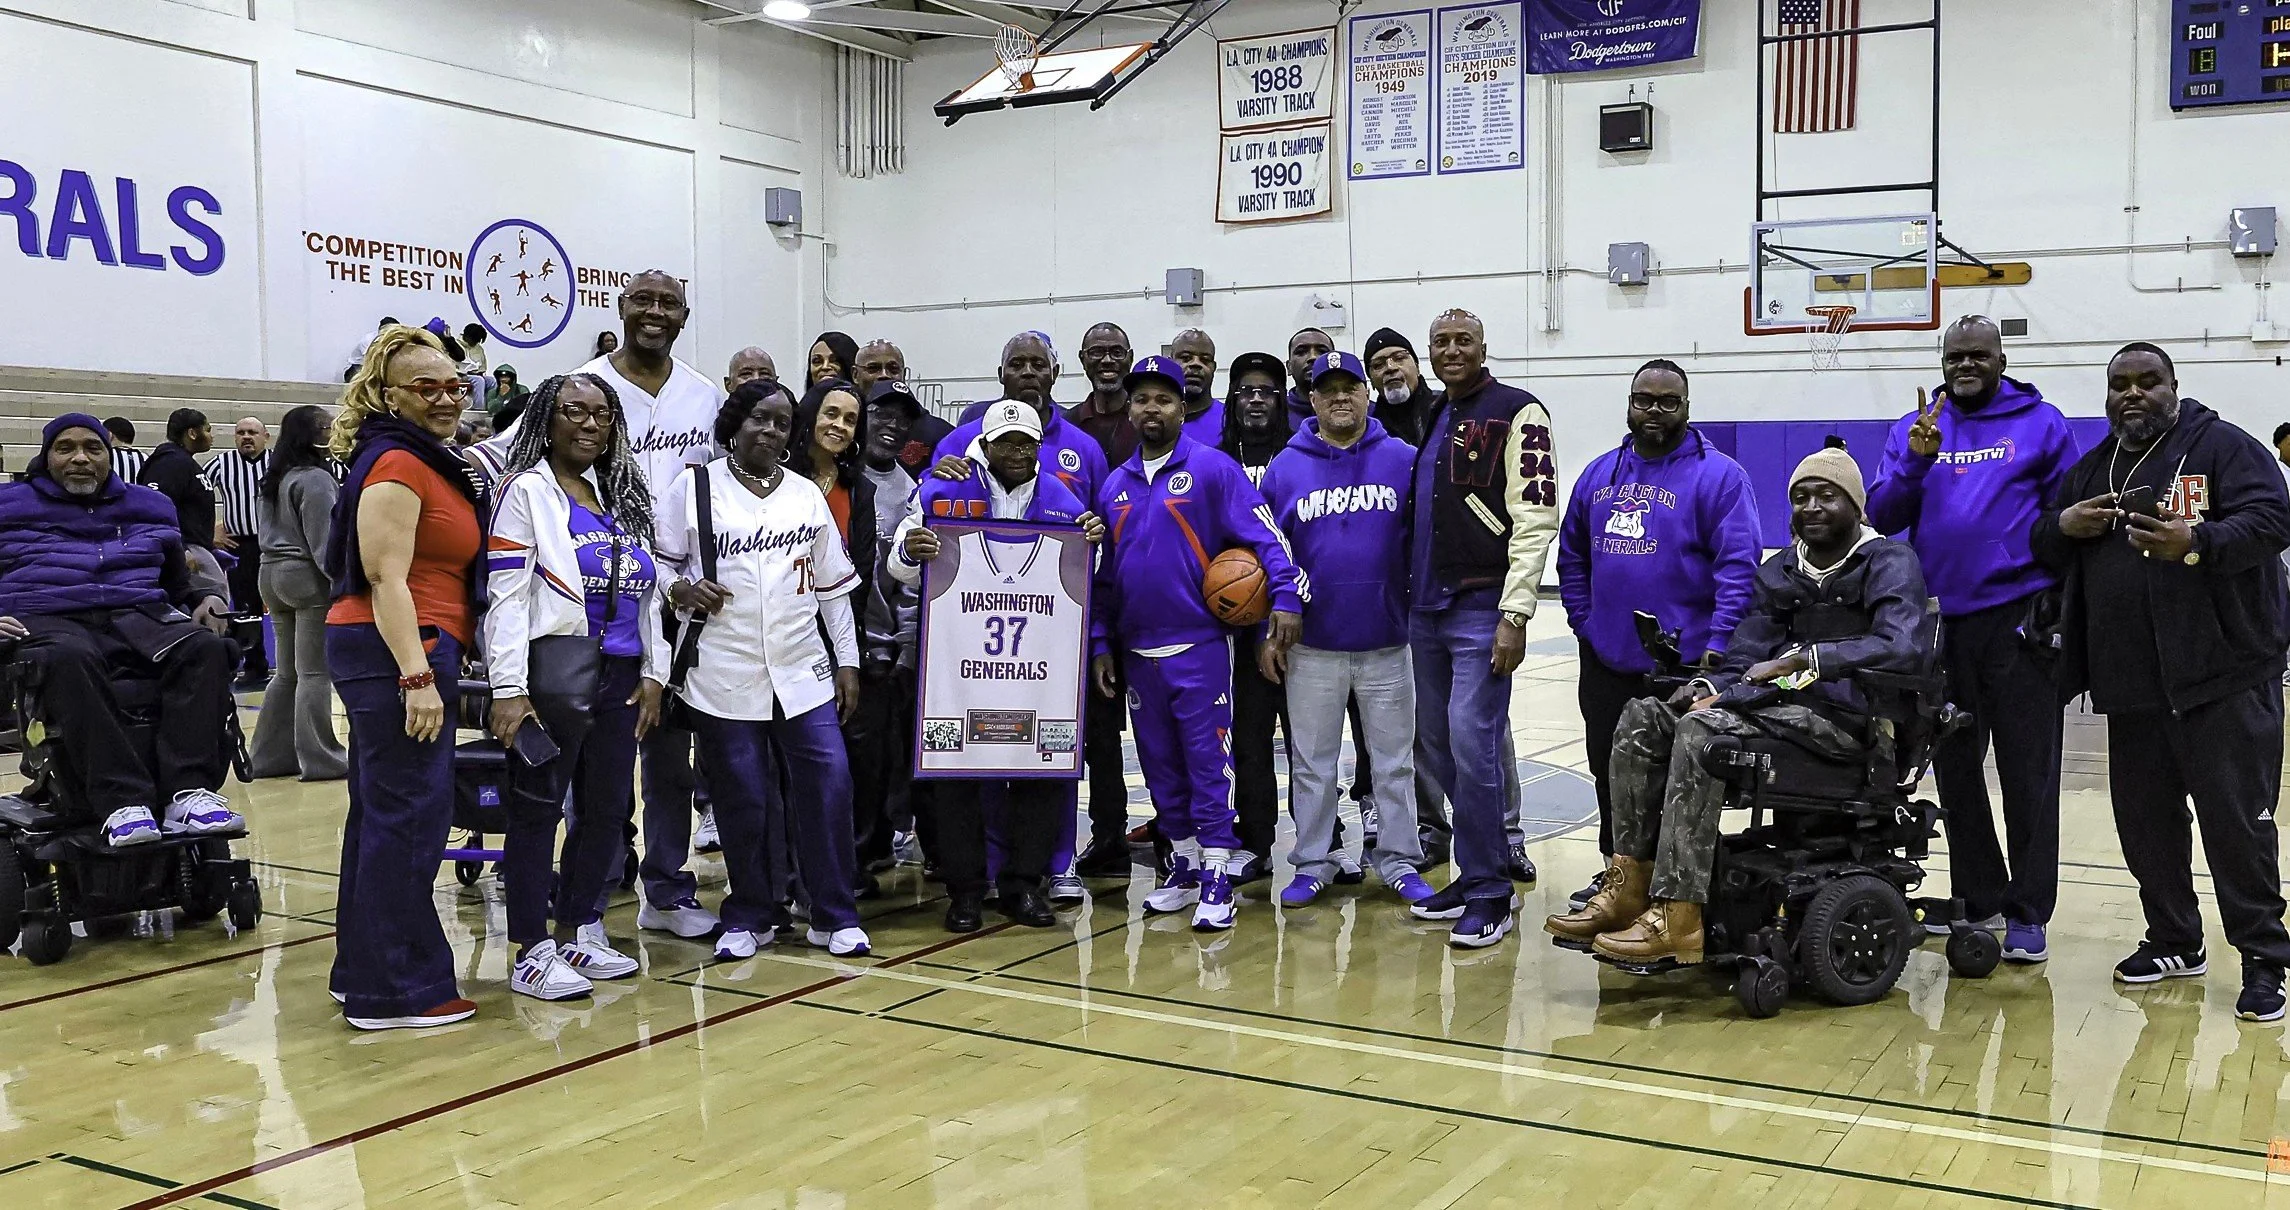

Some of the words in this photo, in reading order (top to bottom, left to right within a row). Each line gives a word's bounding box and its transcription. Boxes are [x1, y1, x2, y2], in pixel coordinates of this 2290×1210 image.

[1540, 30, 1563, 41] LEARN
[1566, 29, 1589, 38] MORE
[2188, 23, 2217, 40] Foul
[1243, 47, 1262, 66] CITY
[1266, 45, 1277, 62] 4A
[1281, 37, 1328, 61] CHAMPIONS
[1471, 42, 1496, 51] SECTION
[1569, 41, 1656, 65] Dodgertown
[1355, 64, 1375, 72] BOYS
[1377, 60, 1424, 70] BASKETBALL
[1355, 67, 1425, 82] CHAMPIONS
[1444, 57, 1517, 74] CHAMPIONS
[1250, 64, 1303, 94] 1988
[1375, 80, 1405, 94] 1949
[1463, 70, 1498, 84] 2019
[2190, 84, 2216, 95] won
[1237, 96, 1278, 118] VARSITY
[1283, 91, 1316, 113] TRACK
[1245, 143, 1264, 161] CITY
[1268, 141, 1277, 158] 4A
[1251, 162, 1302, 189] 1990
[1238, 192, 1278, 213] VARSITY
[1283, 188, 1316, 209] TRACK
[326, 260, 371, 284] THE
[383, 267, 435, 291] BEST
[444, 275, 464, 294] IN
[577, 289, 610, 309] THE
[1145, 357, 1159, 372] LA
[630, 425, 710, 457] shington
[1450, 419, 1511, 488] W
[1519, 453, 1555, 479] 34
[1521, 480, 1556, 507] 43
[1593, 482, 1676, 510] WAHINGTON
[1593, 536, 1658, 555] GNERALS
[582, 575, 651, 590] GENRALS
[960, 591, 1055, 617] WASHINGTON
[983, 615, 1029, 658] 37
[960, 659, 1048, 681] GENERALS
